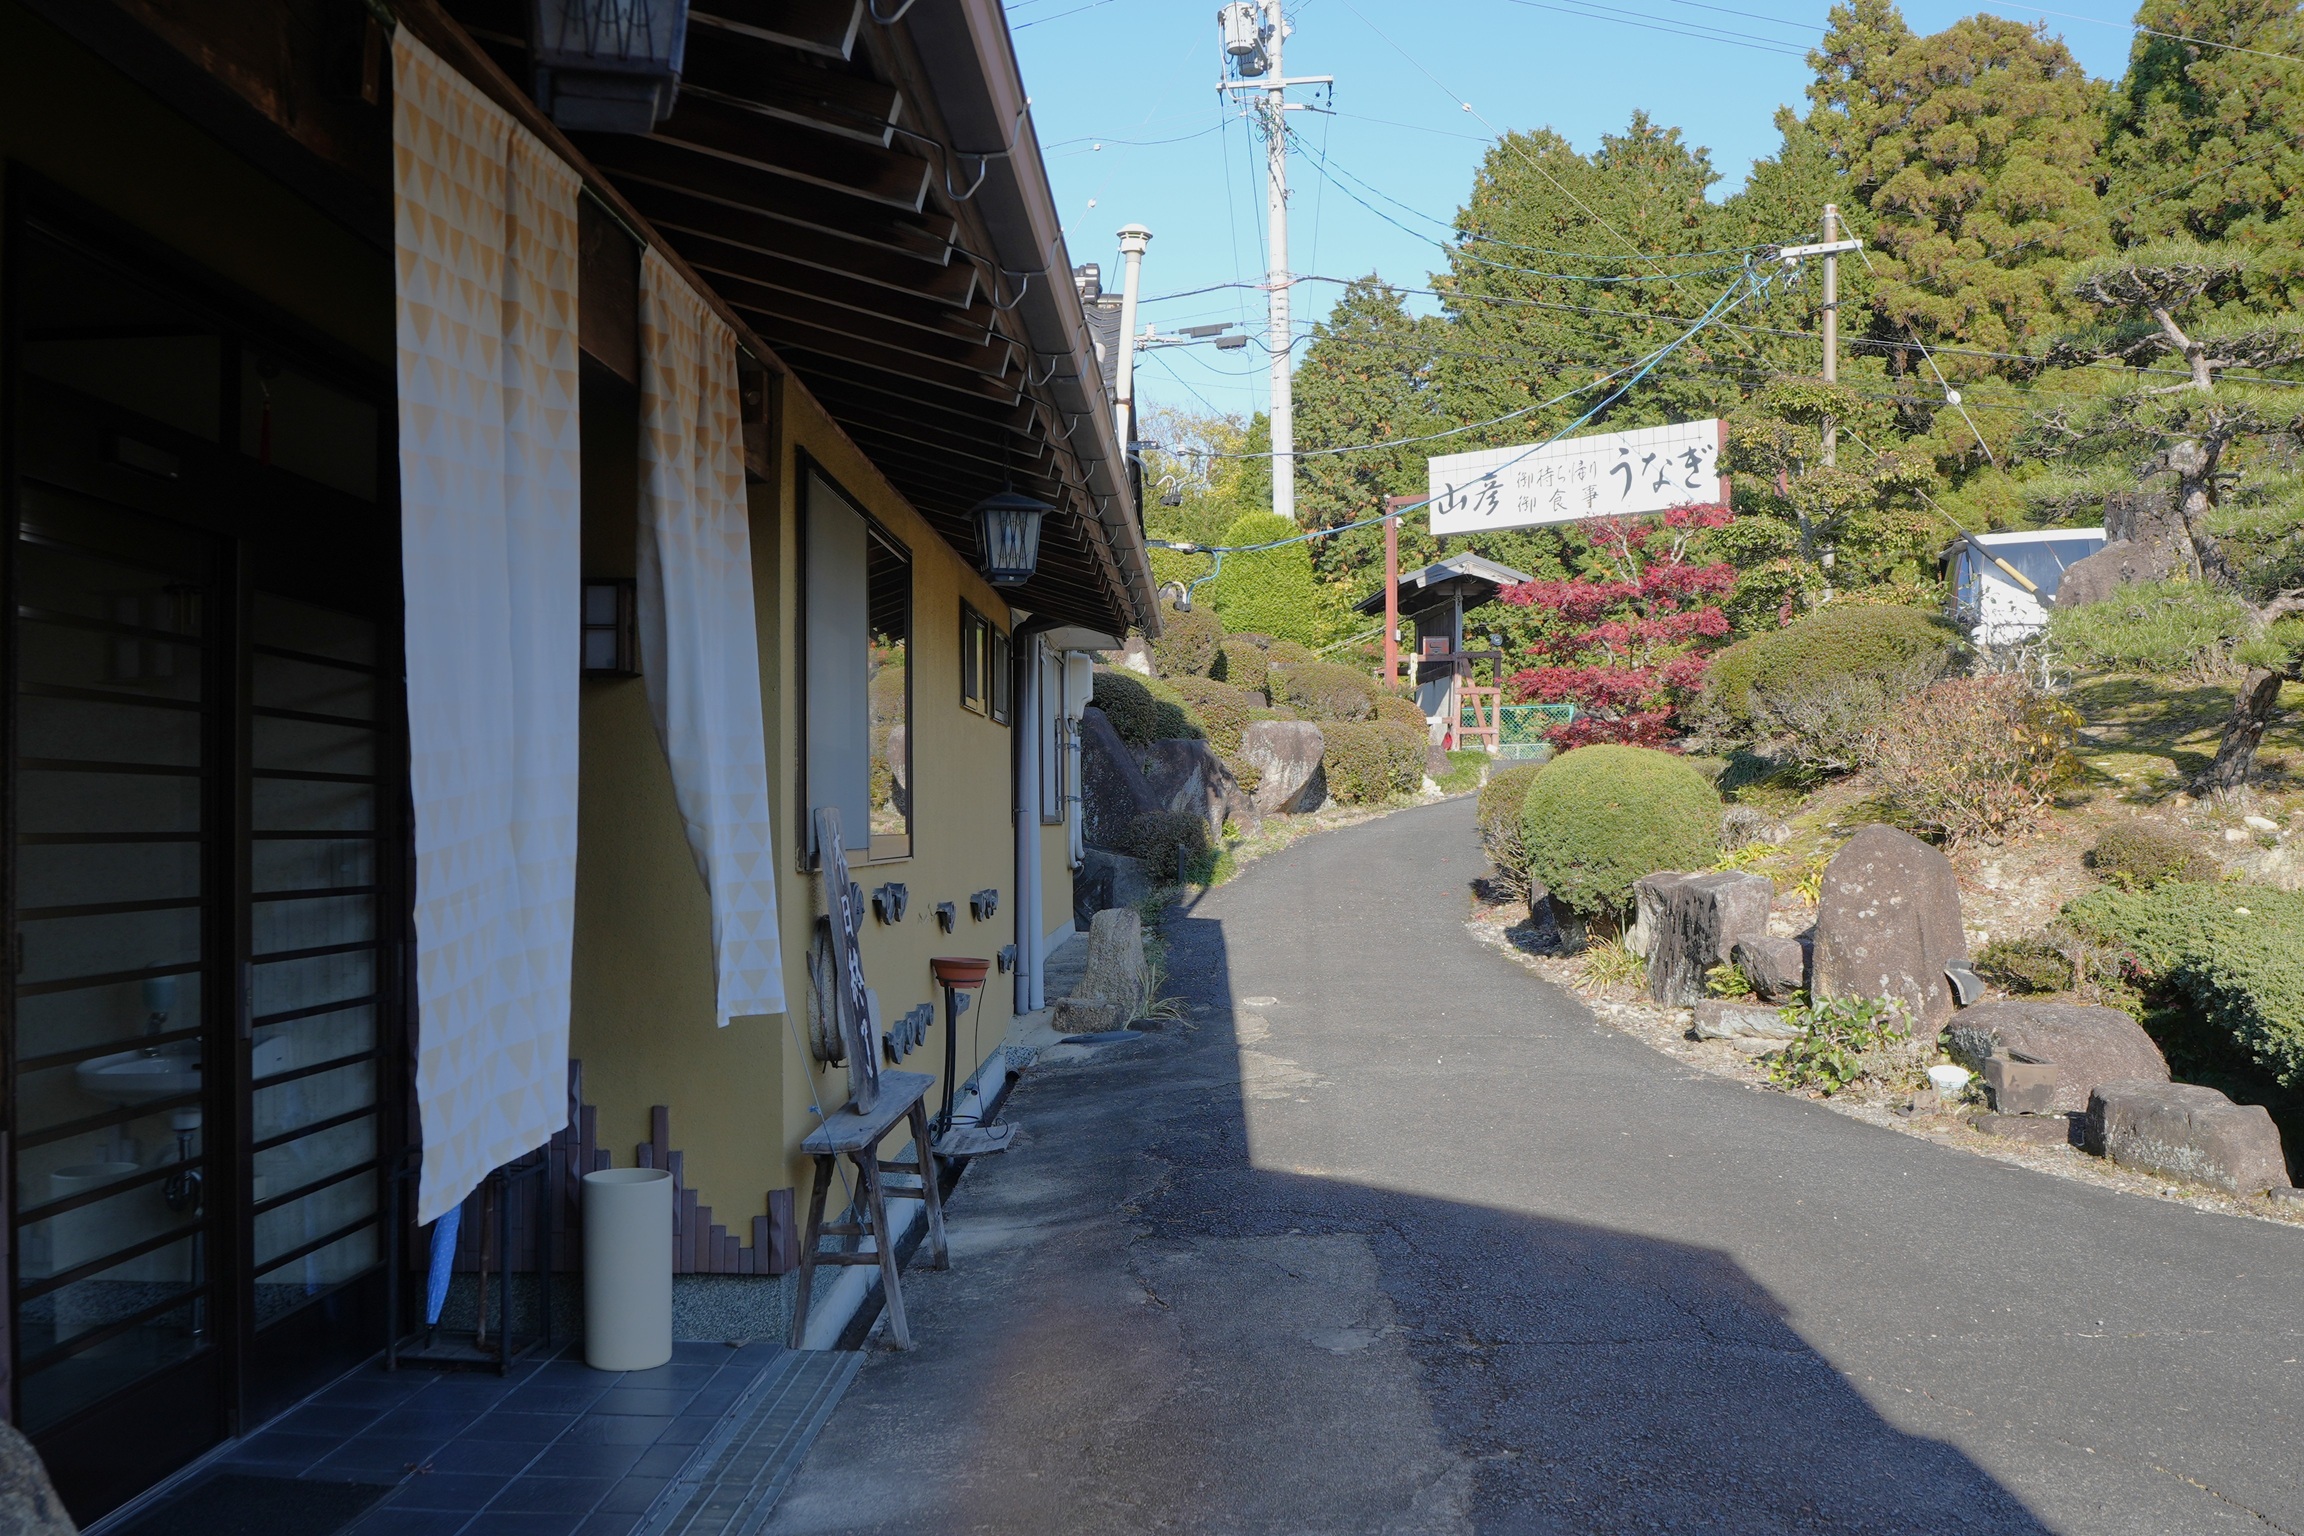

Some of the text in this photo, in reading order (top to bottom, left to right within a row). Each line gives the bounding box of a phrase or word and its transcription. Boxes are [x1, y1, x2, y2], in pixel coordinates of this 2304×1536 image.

[1516, 460, 1597, 488] 御持ち帰り
[1609, 444, 1713, 502] うなぎ
[1438, 472, 1504, 516] 山彦
[1517, 485, 1599, 514] 御食事
